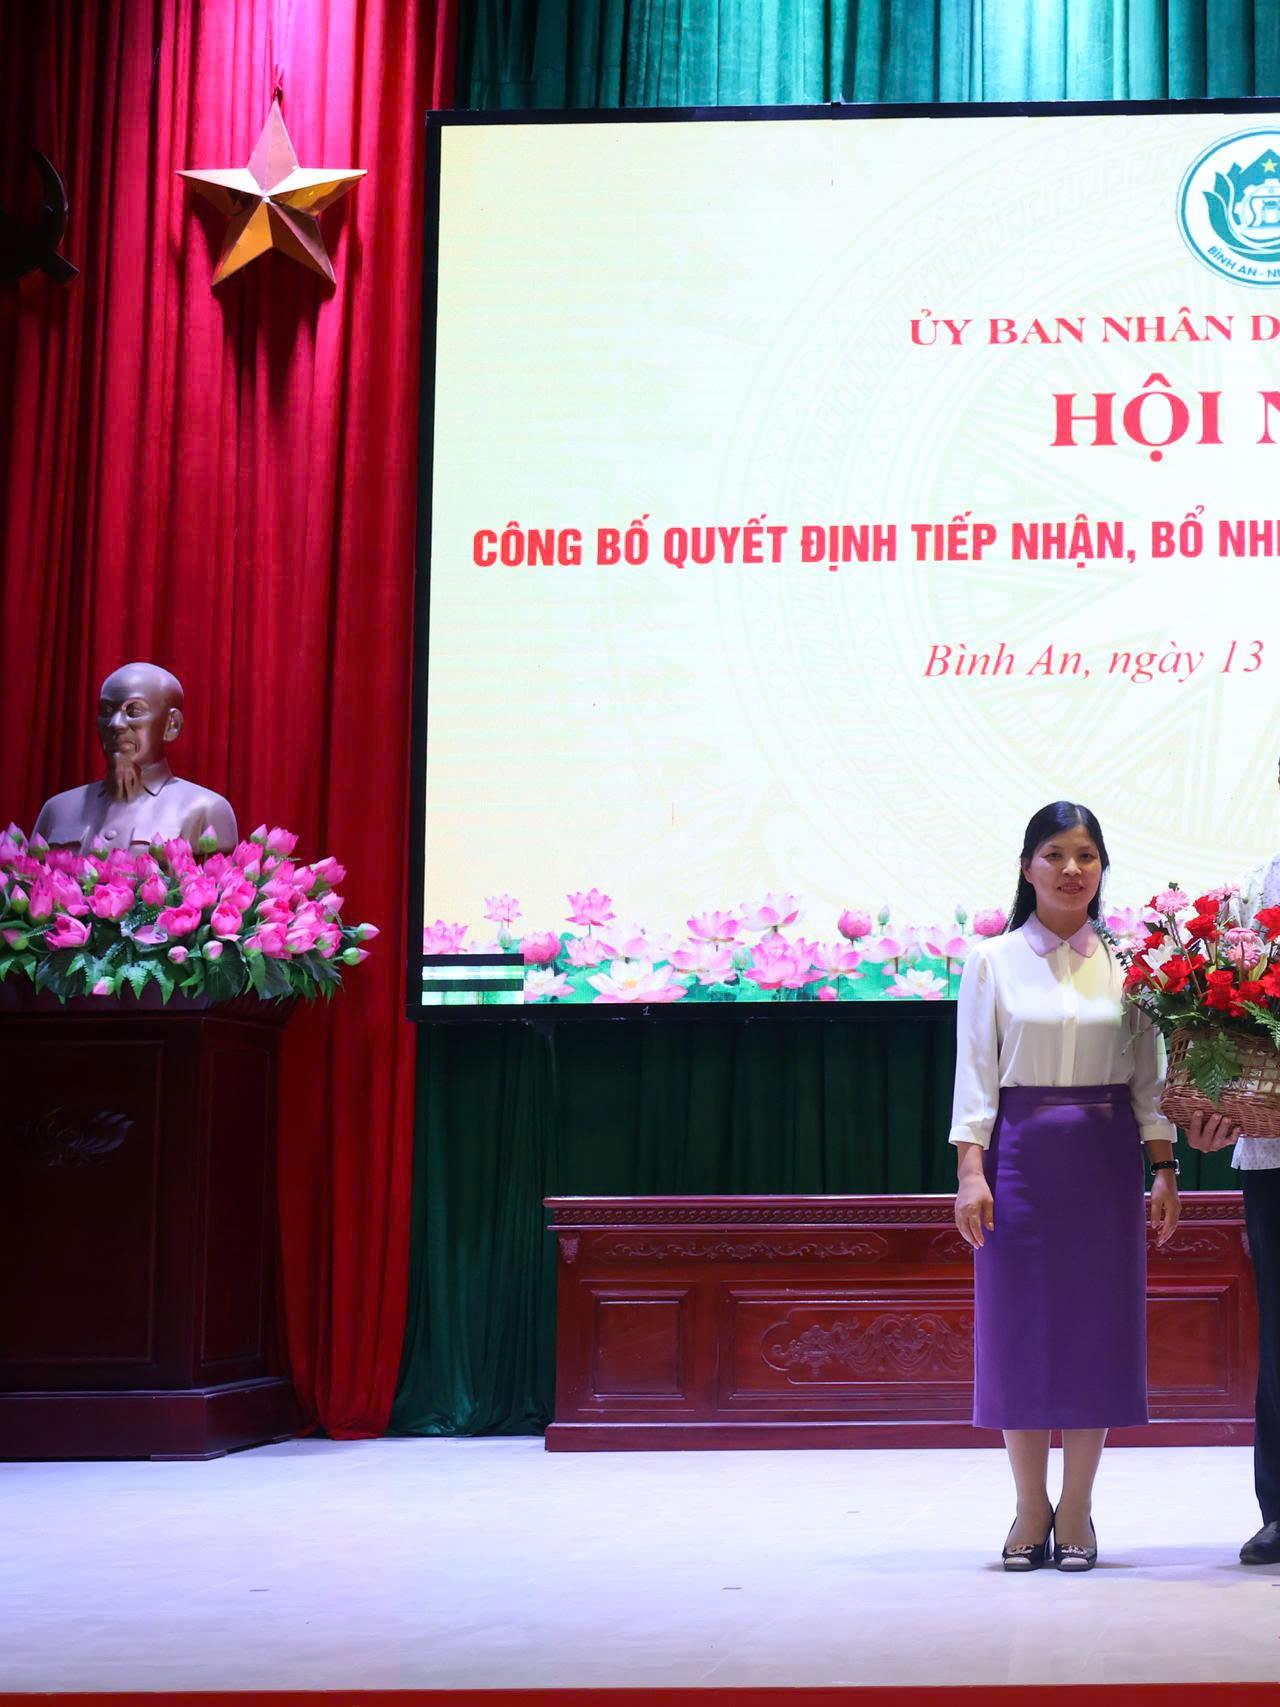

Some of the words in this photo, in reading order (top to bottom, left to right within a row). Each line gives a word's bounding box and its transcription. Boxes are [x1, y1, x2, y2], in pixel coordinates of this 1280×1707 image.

[1207, 245, 1236, 271] BÌNH
[1237, 263, 1258, 277] AN
[910, 308, 972, 346] ỦY
[988, 315, 1086, 345] BAN
[1102, 304, 1234, 344] NHÂN
[1050, 372, 1223, 463] HỘI
[472, 520, 583, 568] CÔNG
[596, 513, 651, 566] BỐ
[663, 513, 789, 569] QUYẾT
[800, 523, 897, 573] ĐỊNH
[911, 511, 998, 562] TIẾP
[1011, 513, 1137, 569] NHẬN,
[1151, 505, 1206, 559] BỔ
[924, 642, 1015, 678] Bình
[1026, 643, 1090, 680] An,
[1108, 641, 1205, 684] ngày
[1220, 640, 1264, 673] 13
